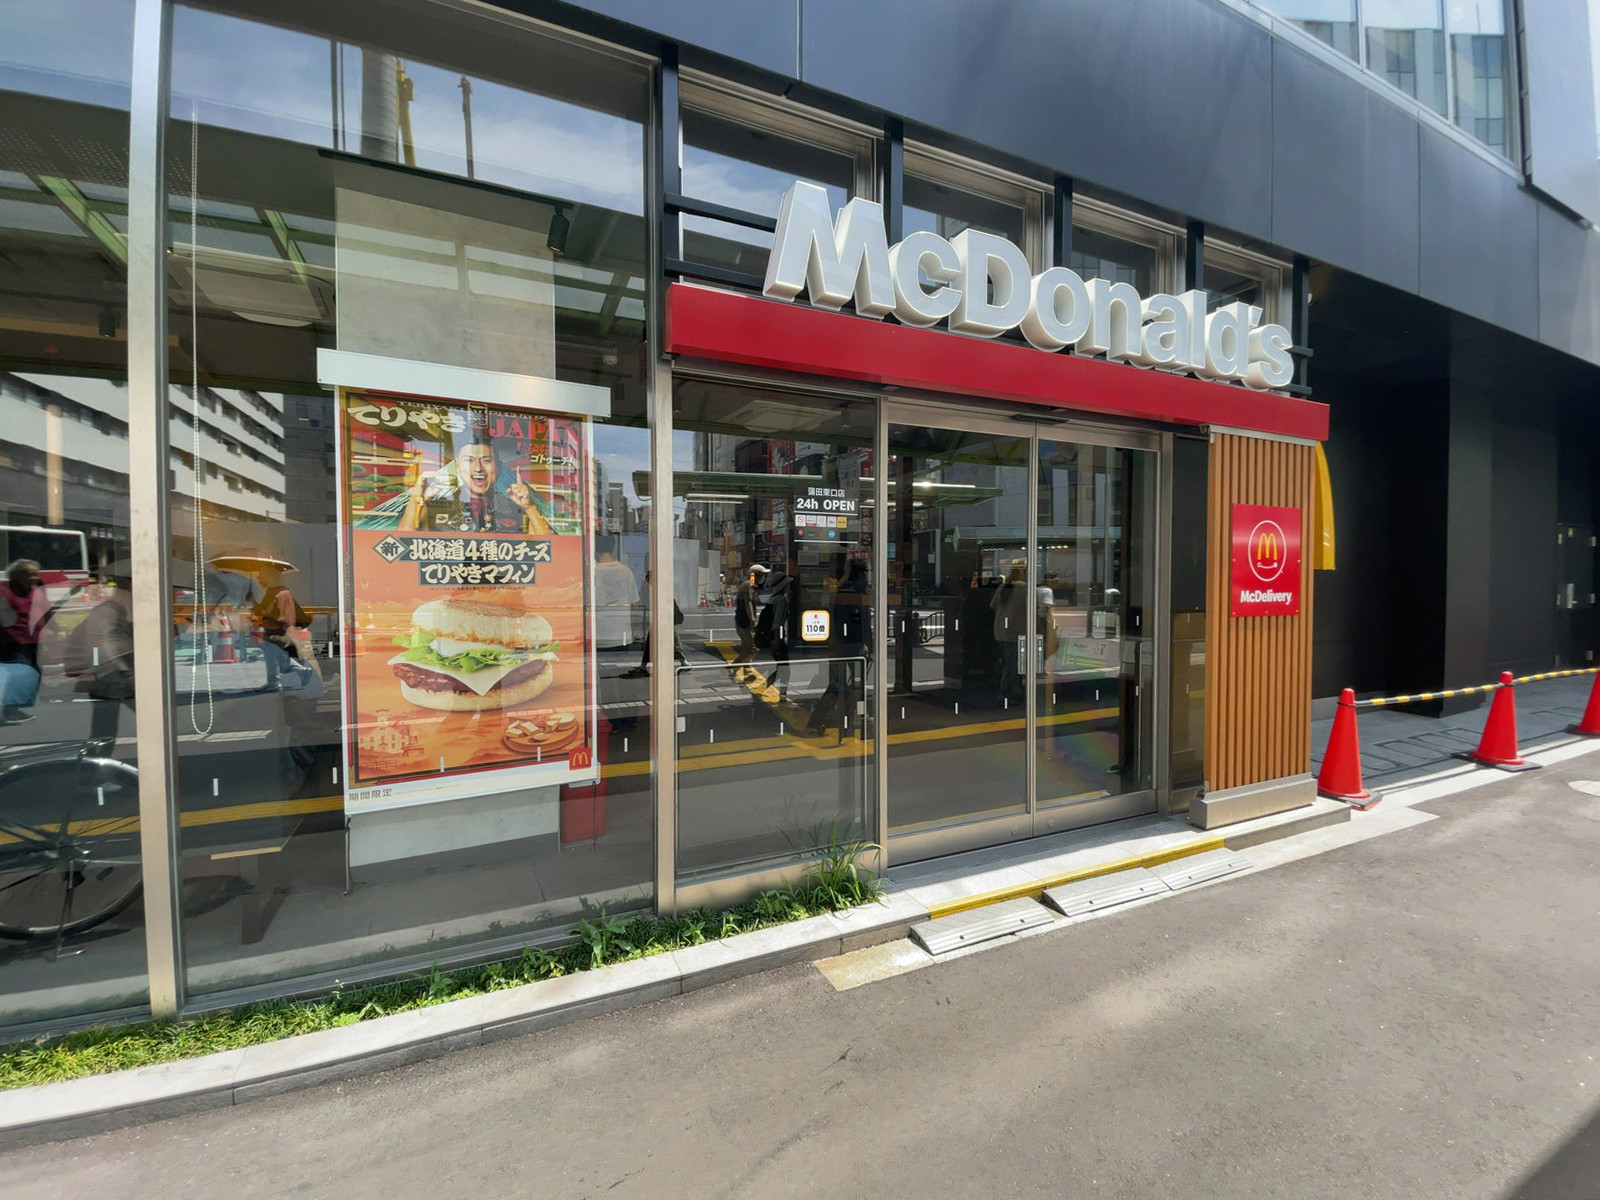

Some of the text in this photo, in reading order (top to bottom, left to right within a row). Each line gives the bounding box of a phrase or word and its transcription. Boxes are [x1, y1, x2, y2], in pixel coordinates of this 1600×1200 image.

[763, 180, 1294, 392] McDonald's
[347, 404, 466, 433] てりやき
[488, 418, 581, 444] JAPAN
[796, 497, 855, 512] 24h OPEN
[380, 541, 400, 557] 新
[409, 539, 551, 562] 北海道4種のチーズ
[421, 563, 536, 584] てりやきマフィン
[1240, 589, 1292, 605] McDelivery
[348, 788, 393, 802] 期間限定
